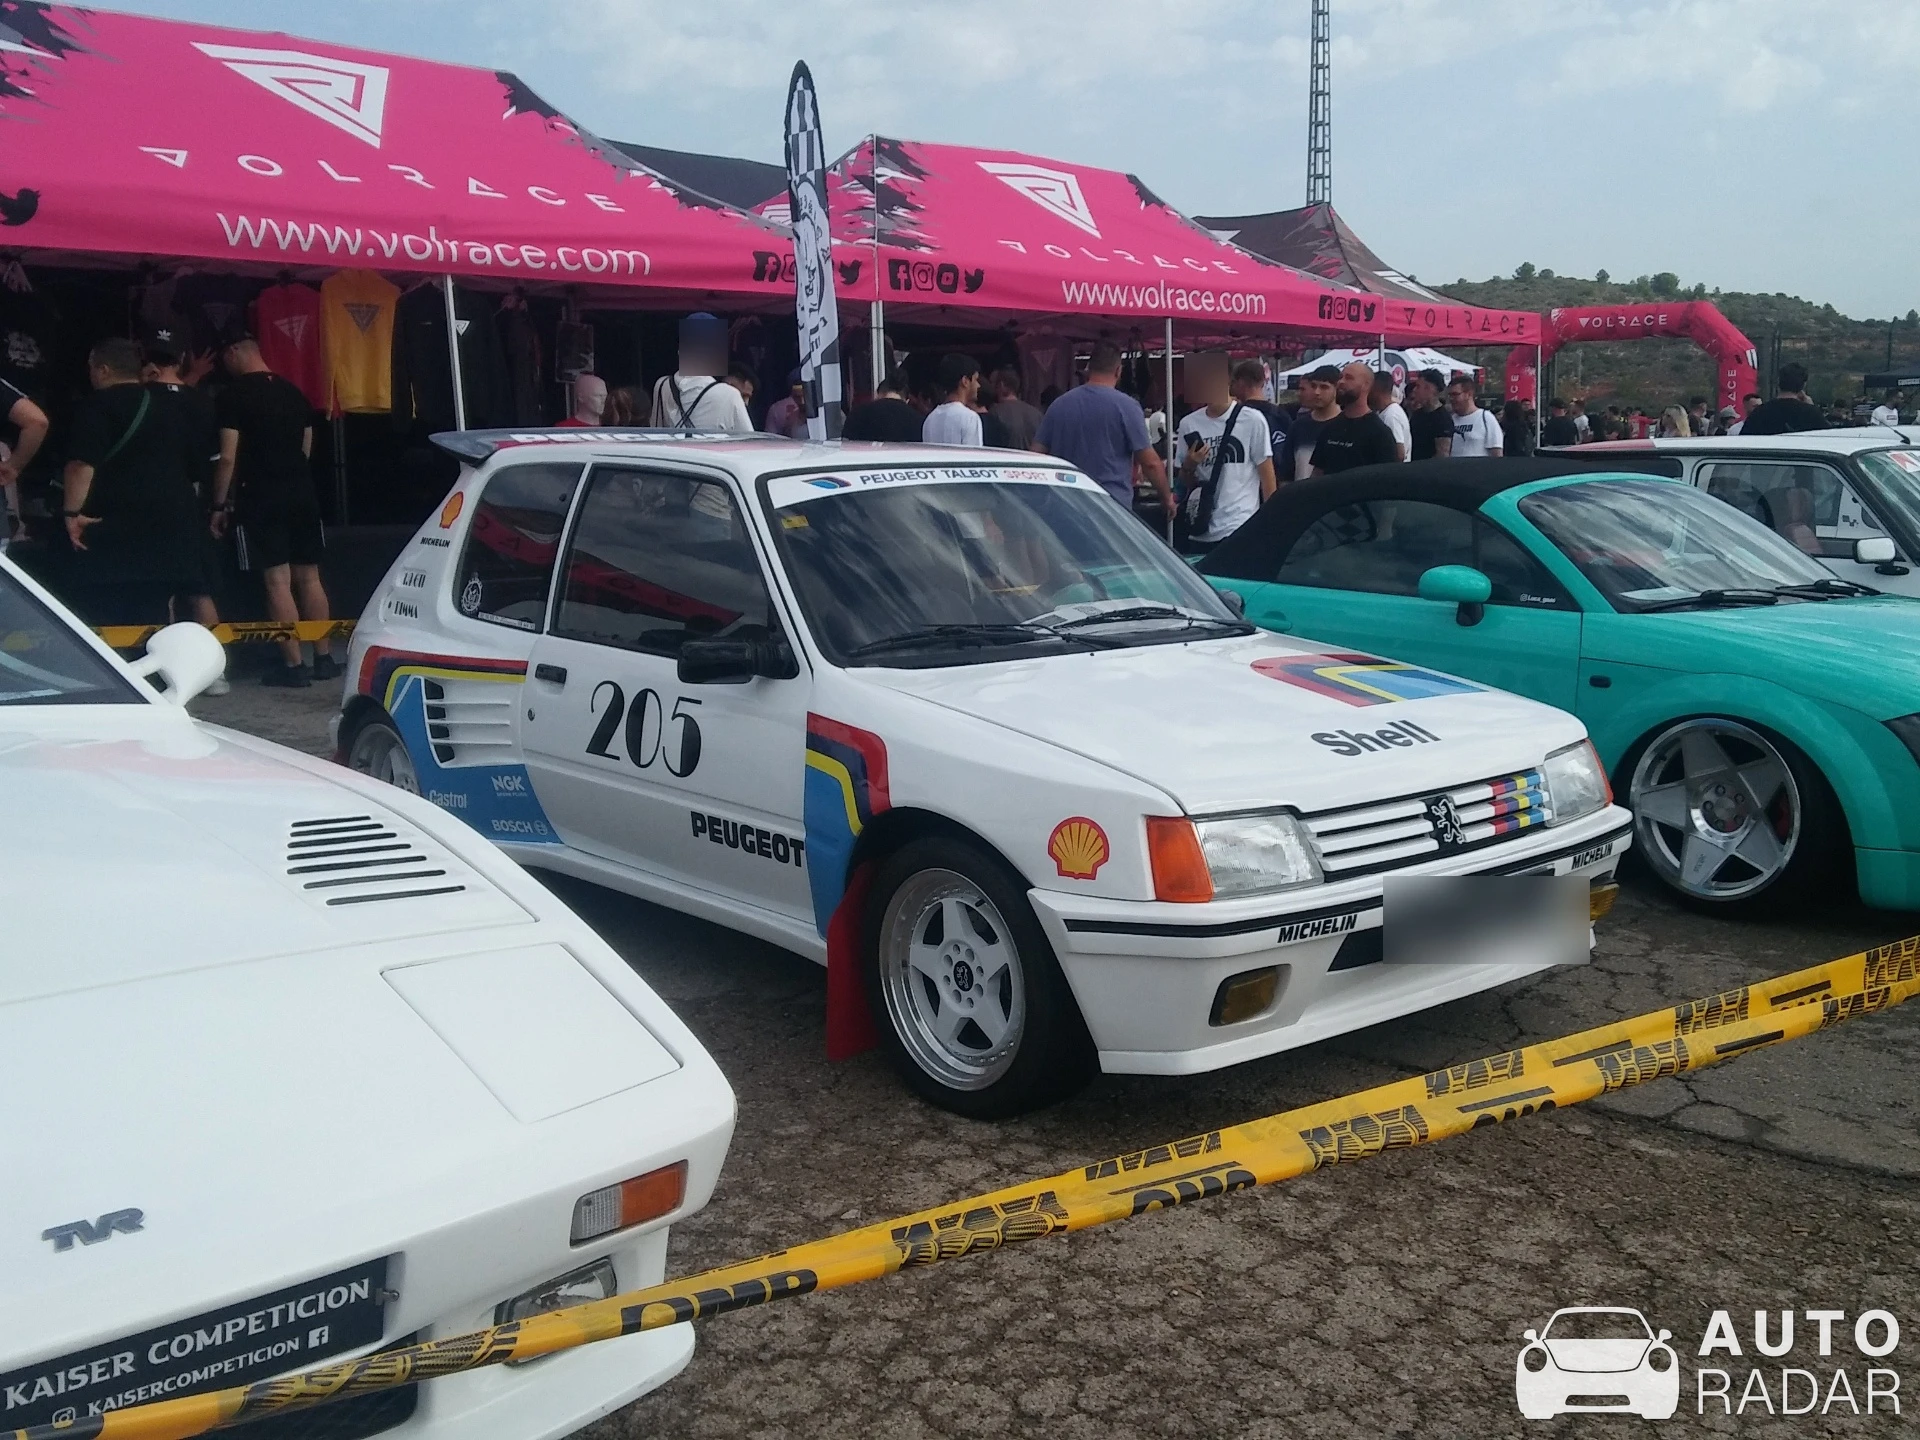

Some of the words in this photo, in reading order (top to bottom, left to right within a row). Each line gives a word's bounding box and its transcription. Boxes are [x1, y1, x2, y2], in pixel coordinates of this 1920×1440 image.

[216, 212, 651, 276] www.volrace.com
[1061, 279, 1266, 316] www.volrace.com
[1403, 307, 1525, 335] VOLRACE
[1578, 314, 1668, 329] VOLRACE
[859, 470, 936, 485] PEUGEOT
[941, 469, 999, 479] TALBOT
[1003, 470, 1048, 481] SPORT
[420, 536, 451, 548] MICHELIN
[585, 680, 703, 778] 205
[1310, 719, 1441, 757] Shell
[491, 775, 525, 791] NGK
[429, 790, 467, 809] Castrol
[491, 820, 534, 834] BOSCH
[690, 811, 805, 867] PEUGEOT
[1571, 843, 1613, 870] MICHELIN
[1277, 914, 1357, 943] MICHELIN
[41, 1207, 145, 1253] TVR
[3, 1350, 136, 1411] KAISER
[147, 1277, 370, 1366] COMPETICION
[87, 1336, 300, 1418] KAISERCOMPETICION
